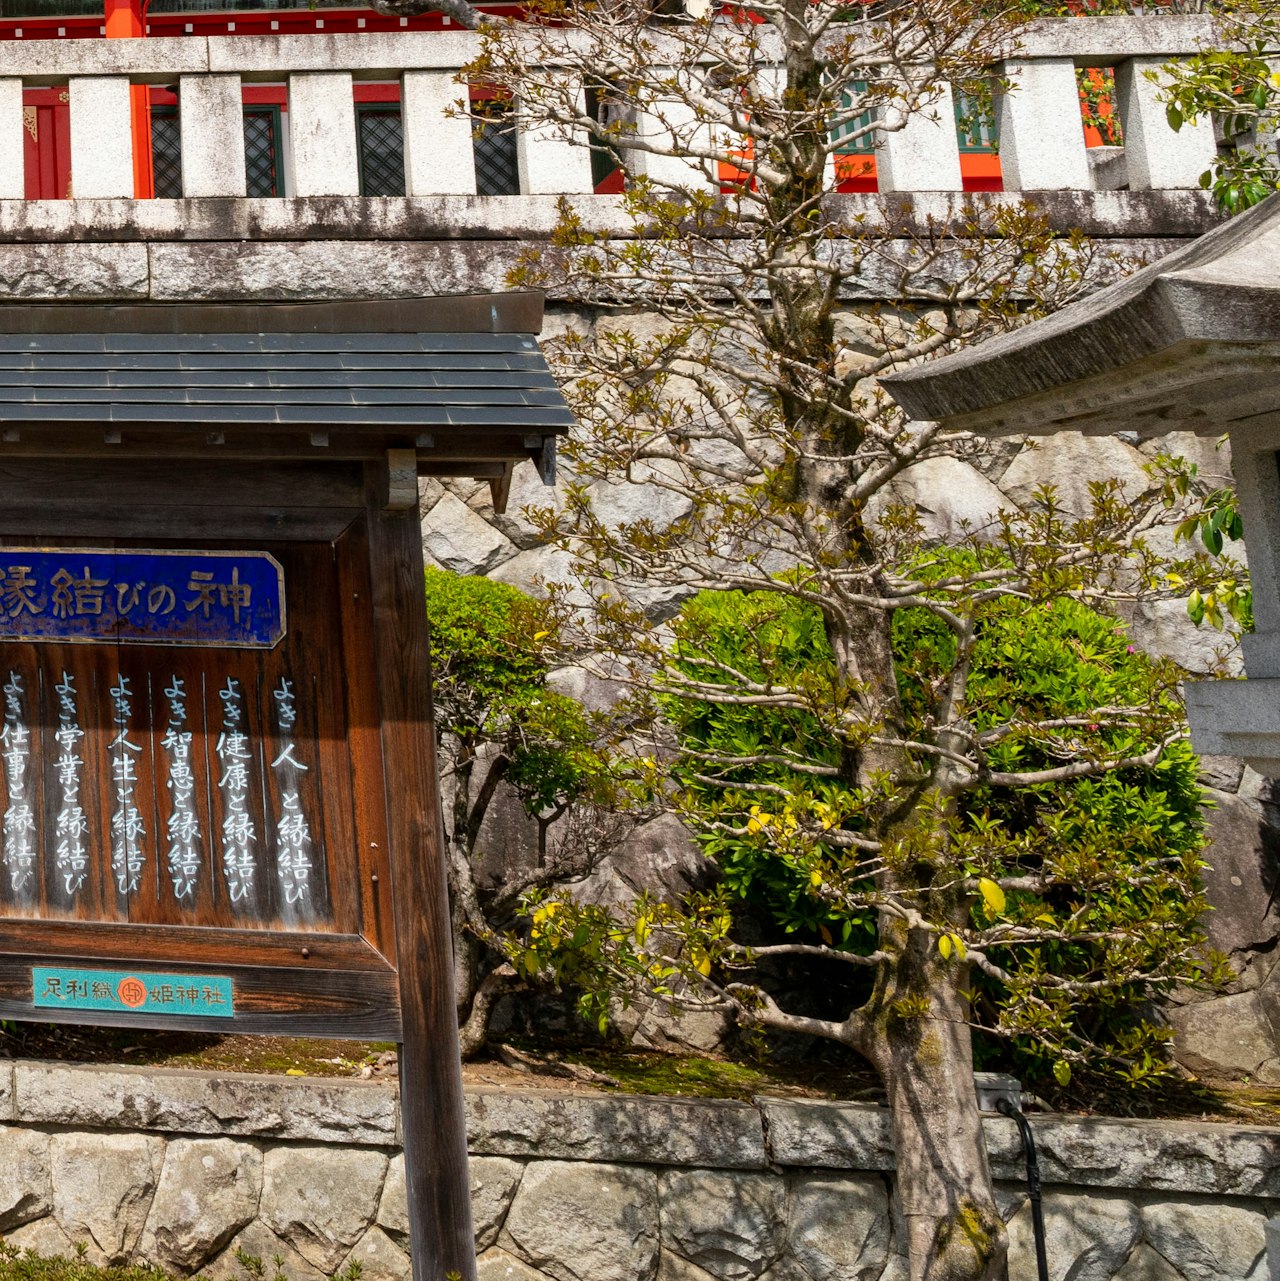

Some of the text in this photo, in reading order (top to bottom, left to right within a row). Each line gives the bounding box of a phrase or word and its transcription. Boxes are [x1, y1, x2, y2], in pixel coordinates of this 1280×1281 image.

[0, 670, 37, 892] よき仕事と縁結び
[53, 671, 90, 895] よき学業と縁結び
[107, 672, 146, 895] よき人生と縁結び
[160, 674, 202, 899] よき智恵と縁結び
[216, 676, 258, 902] よき健康と縁結び
[271, 676, 313, 904] よき人と縁結び
